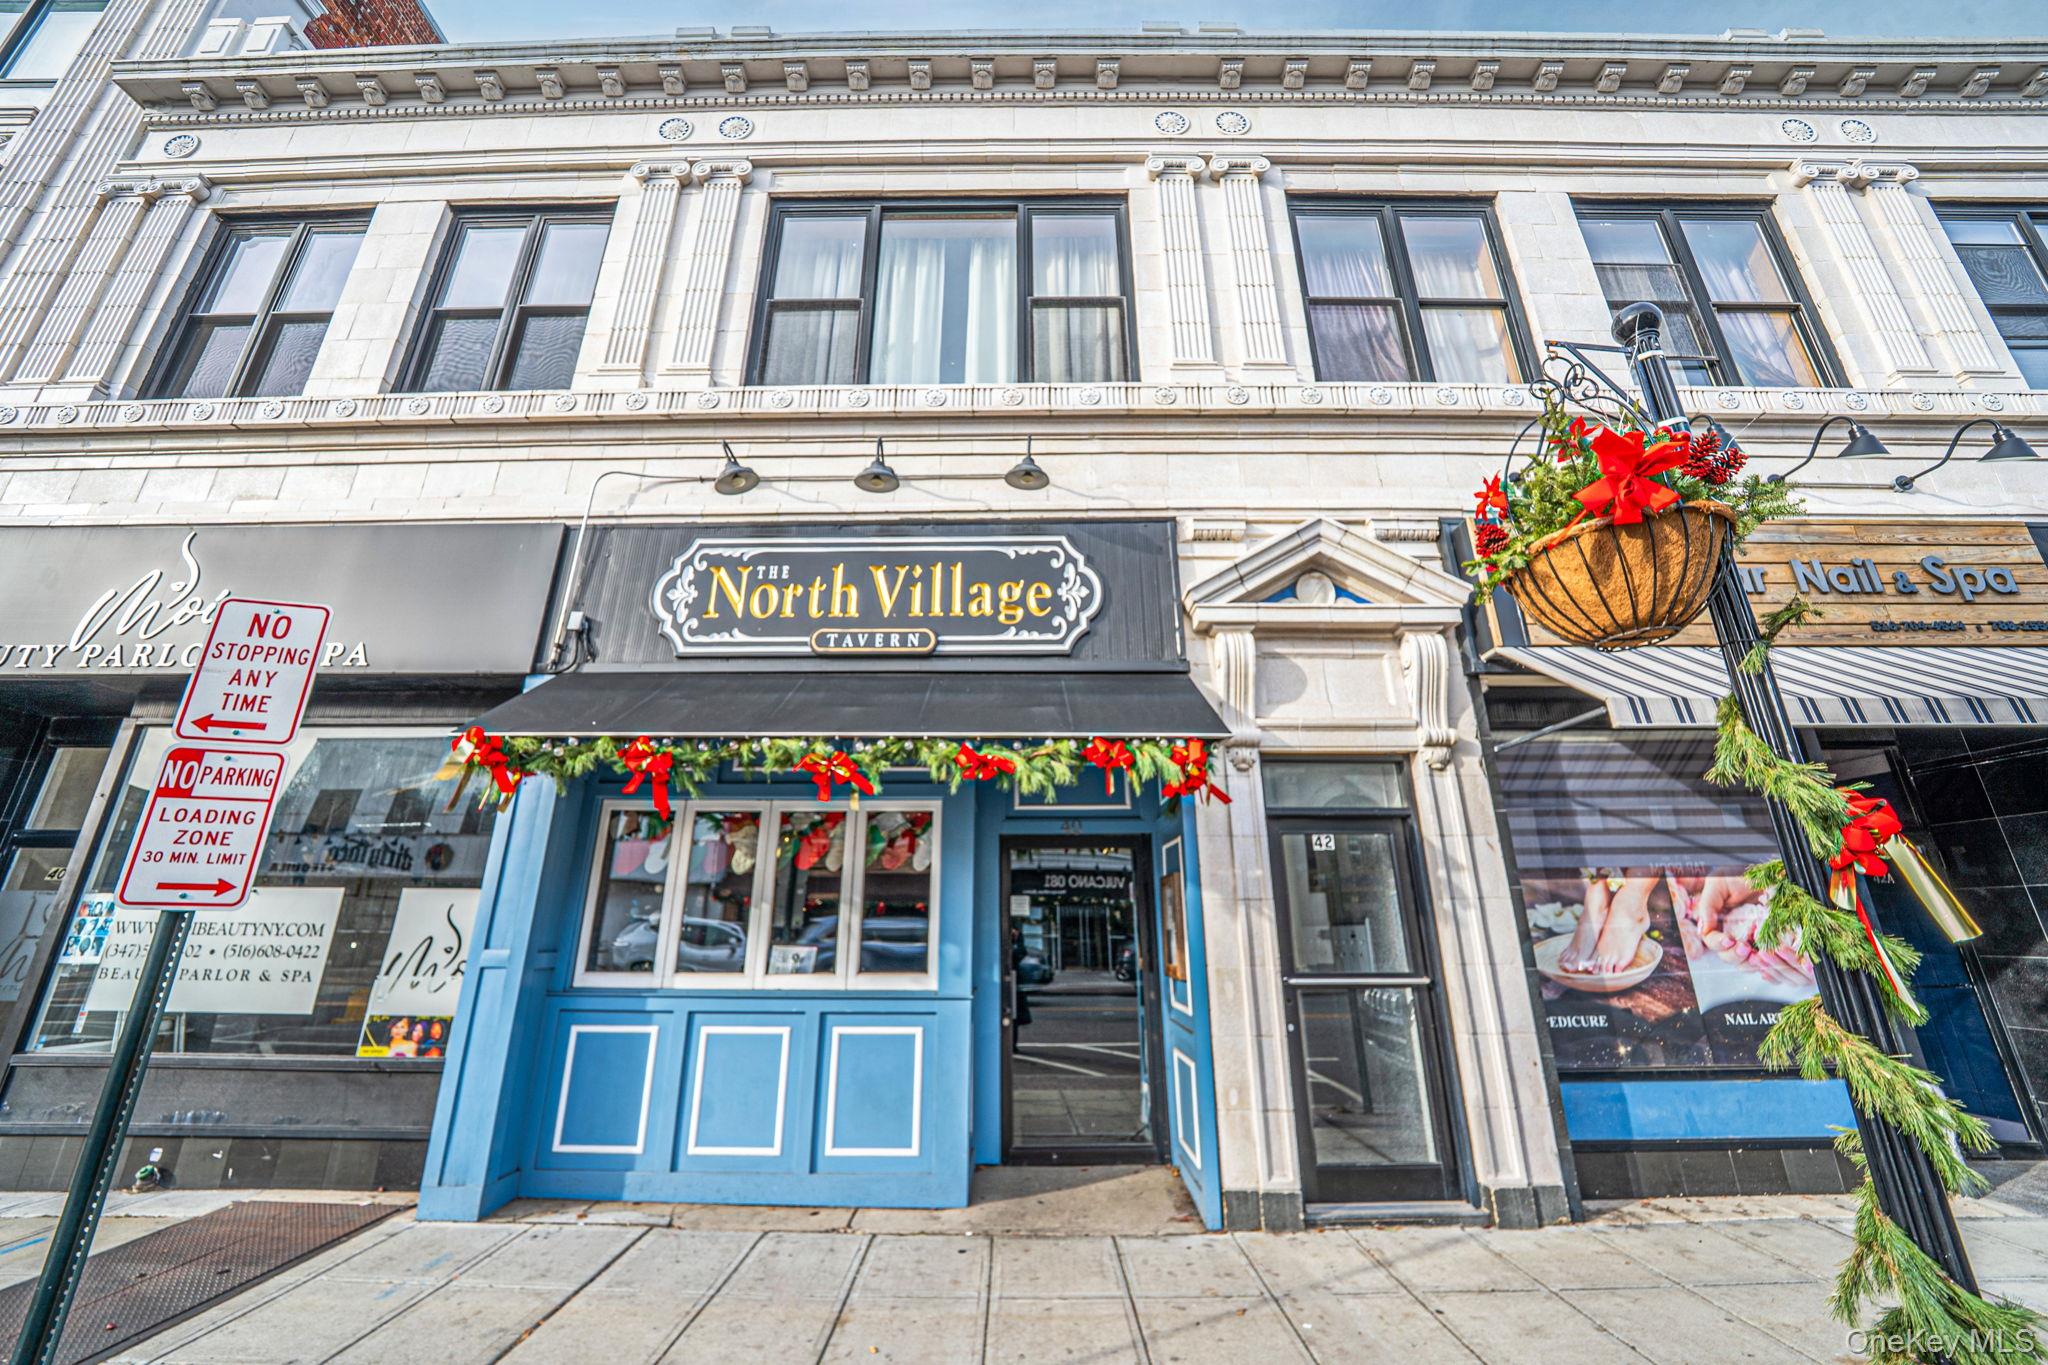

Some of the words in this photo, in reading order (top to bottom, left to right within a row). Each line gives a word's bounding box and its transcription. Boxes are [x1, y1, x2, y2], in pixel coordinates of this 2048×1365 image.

[756, 565, 790, 580] THE
[1788, 558, 1885, 594] Nail
[1891, 571, 1919, 594] &
[1920, 555, 2020, 602] Spa
[702, 562, 860, 619] North
[868, 561, 1052, 625] Village
[246, 612, 293, 640] NO
[826, 633, 920, 648] TAVERN
[75, 642, 204, 669] PARLO
[319, 642, 369, 668] PA
[211, 642, 311, 666] STOPPING
[227, 668, 279, 688] ANY
[221, 692, 273, 714] TIME
[158, 759, 201, 790] NO
[199, 766, 276, 787] PARKING
[158, 807, 257, 826] LOADING
[172, 829, 234, 847] ZONE
[1313, 836, 1333, 849] 42
[141, 850, 164, 863] 30
[168, 851, 200, 865] MIN.
[205, 853, 248, 866] LIMIT
[223, 943, 320, 960] (516)608-0422
[178, 968, 250, 982] PARLOR
[259, 969, 271, 982] &
[281, 969, 312, 982] SPA
[1546, 1015, 1608, 1028] EDICURE
[1724, 1013, 1758, 1026] NAIL
